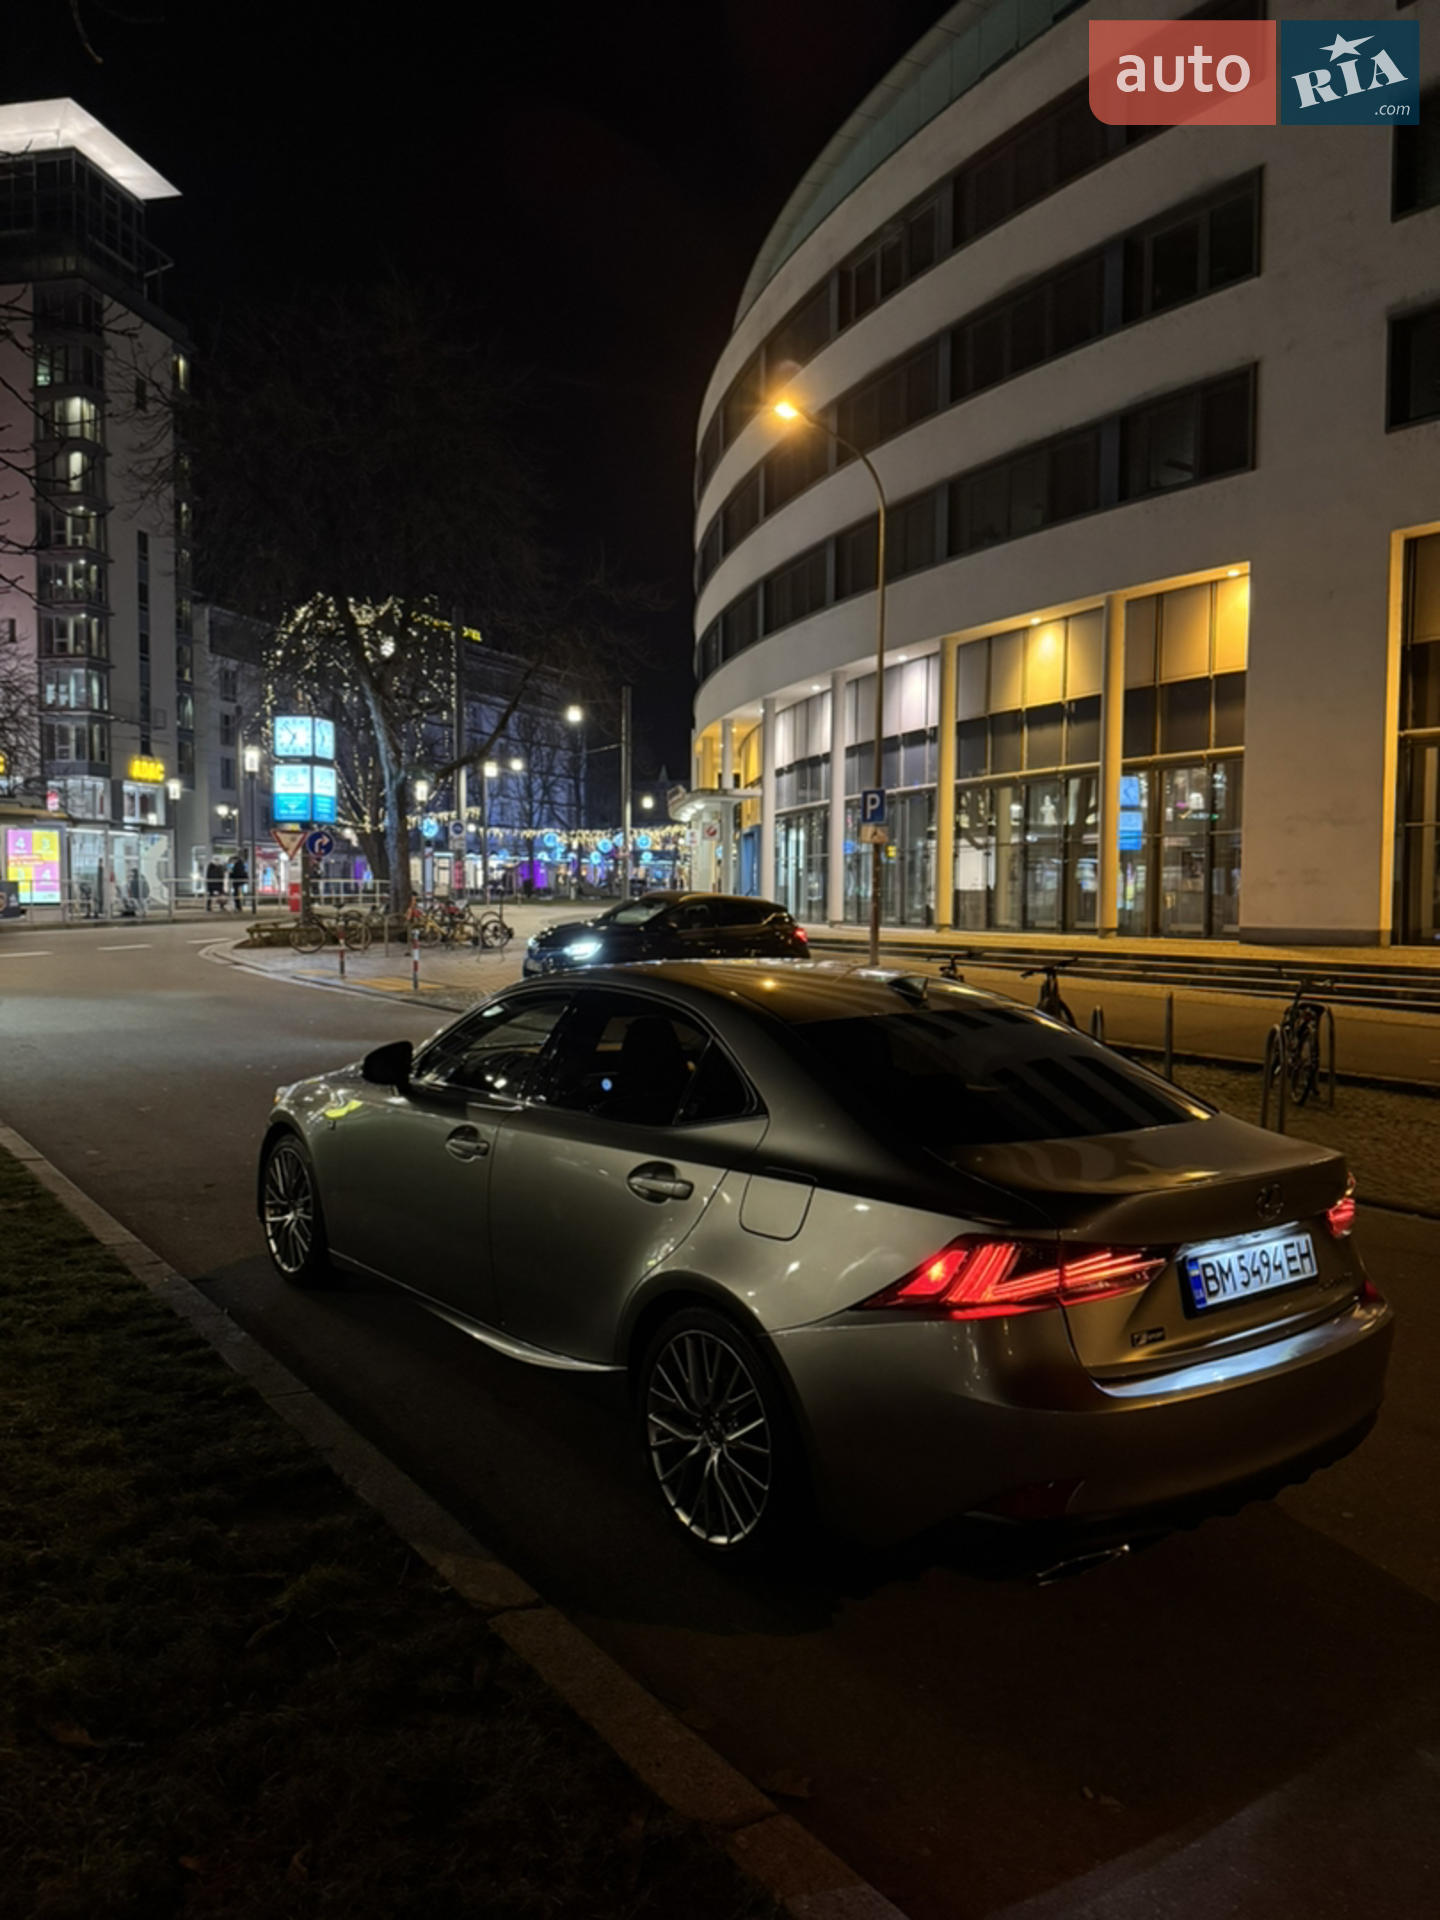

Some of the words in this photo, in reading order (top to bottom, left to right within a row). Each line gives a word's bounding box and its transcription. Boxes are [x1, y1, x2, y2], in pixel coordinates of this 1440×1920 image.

[130, 758, 165, 782] ADAC
[866, 793, 881, 820] P
[1201, 1258, 1237, 1298] BM
[1237, 1246, 1285, 1288] 5494
[1283, 1239, 1315, 1276] EH
